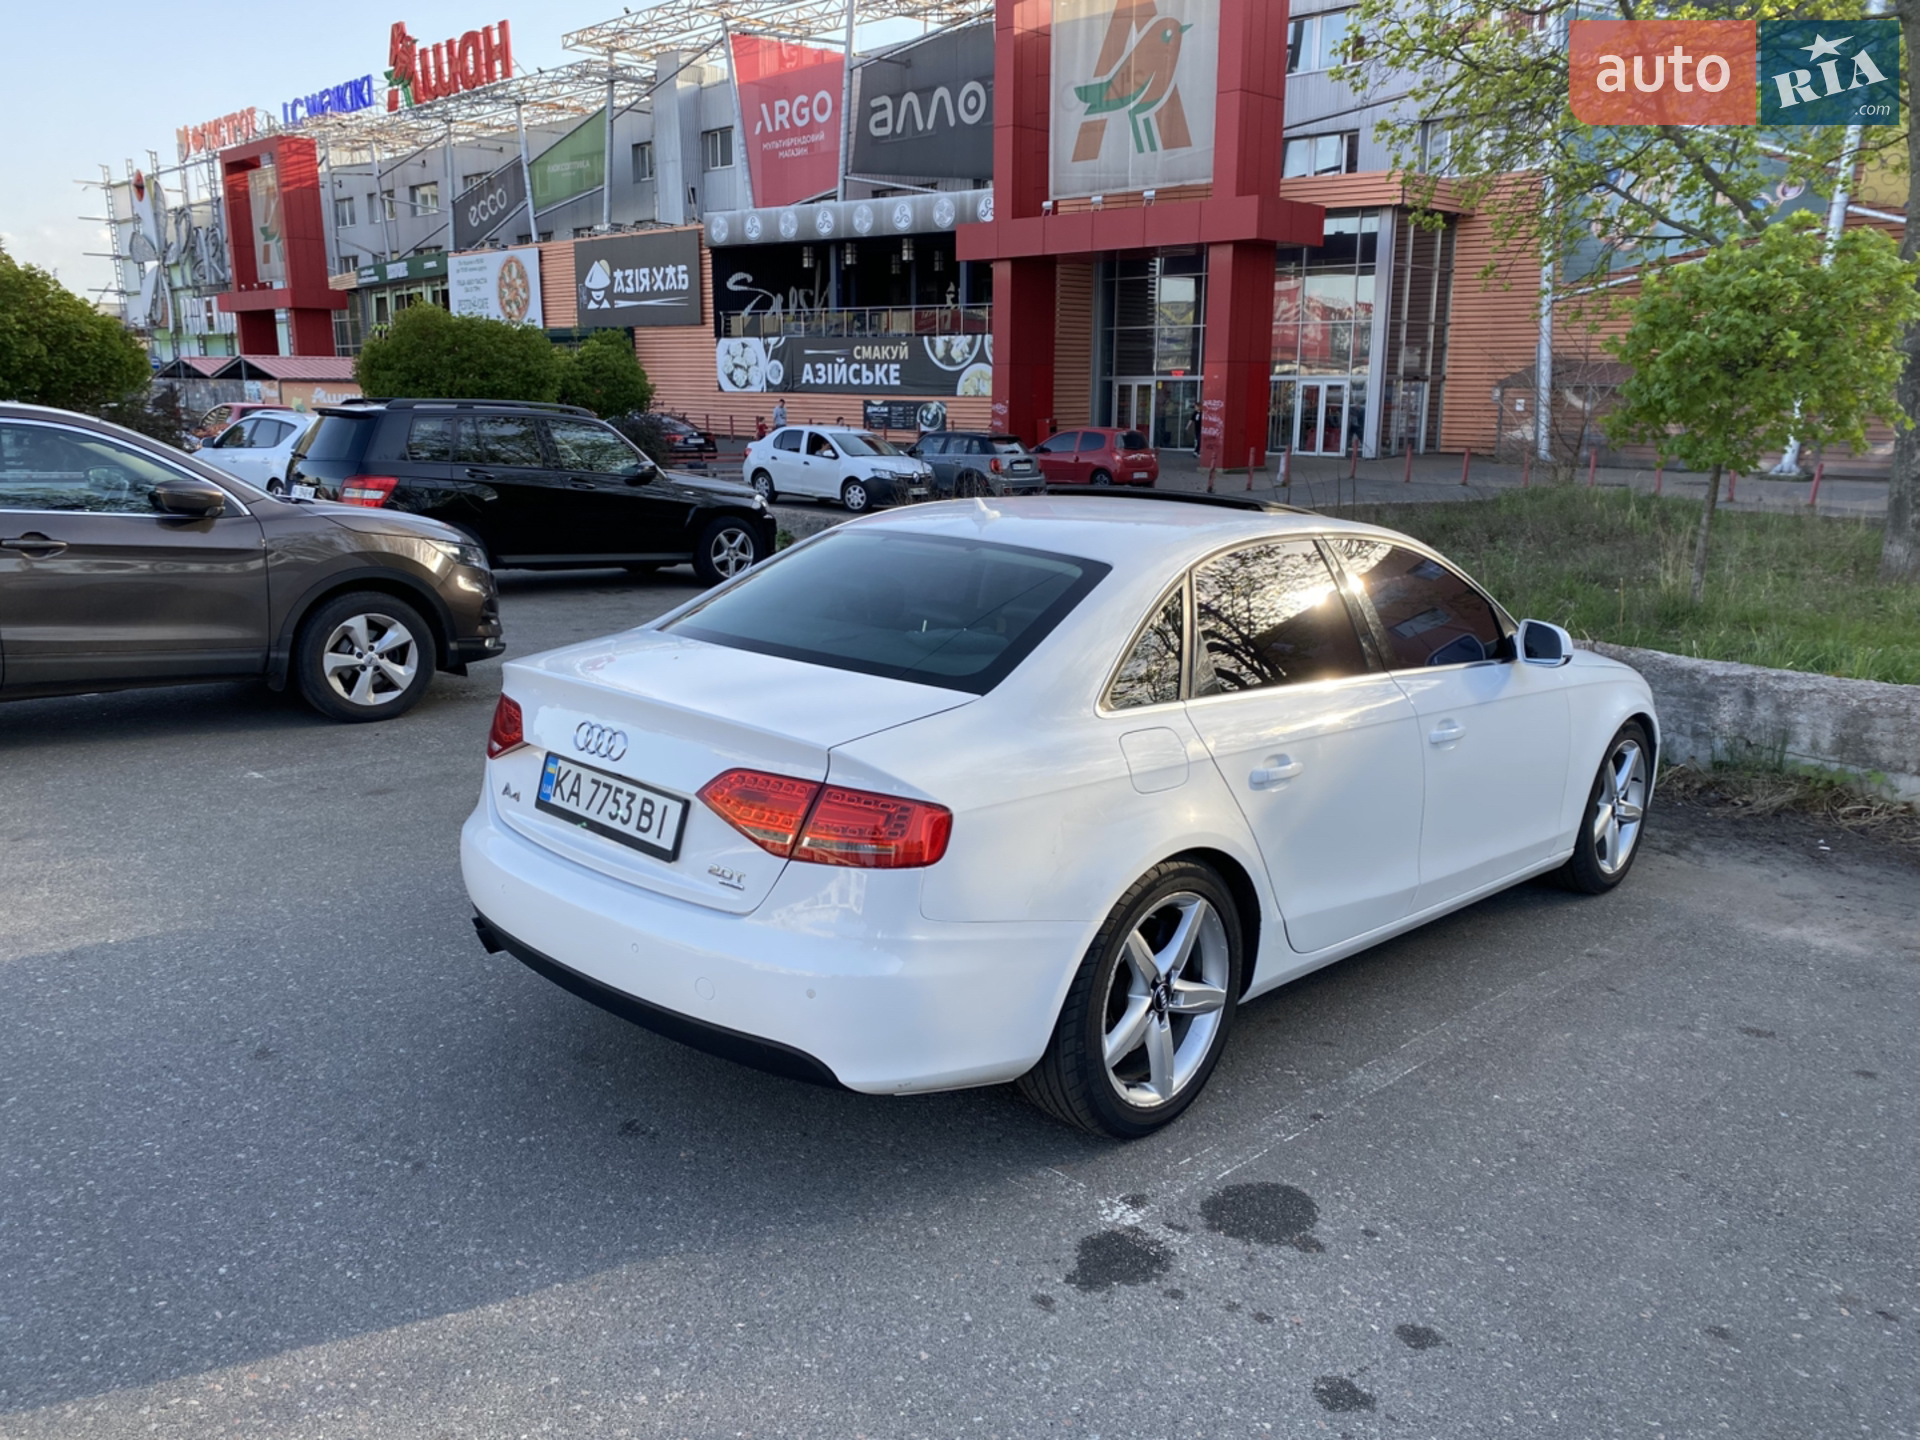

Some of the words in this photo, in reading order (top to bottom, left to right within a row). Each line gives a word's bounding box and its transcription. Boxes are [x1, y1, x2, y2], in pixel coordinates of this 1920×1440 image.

[755, 90, 833, 135] ARGO
[762, 131, 825, 151] МУЛЬТИБРЕНДОВИЙ
[778, 147, 809, 159] МАГАЗИН
[652, 264, 689, 292] ХАБ
[853, 342, 909, 360] СМАКУЙ
[801, 357, 901, 385] АЗІЙСЬКЕ
[501, 782, 521, 802] A4
[552, 765, 582, 807] KA
[585, 778, 637, 826] 7753
[635, 797, 668, 840] BI
